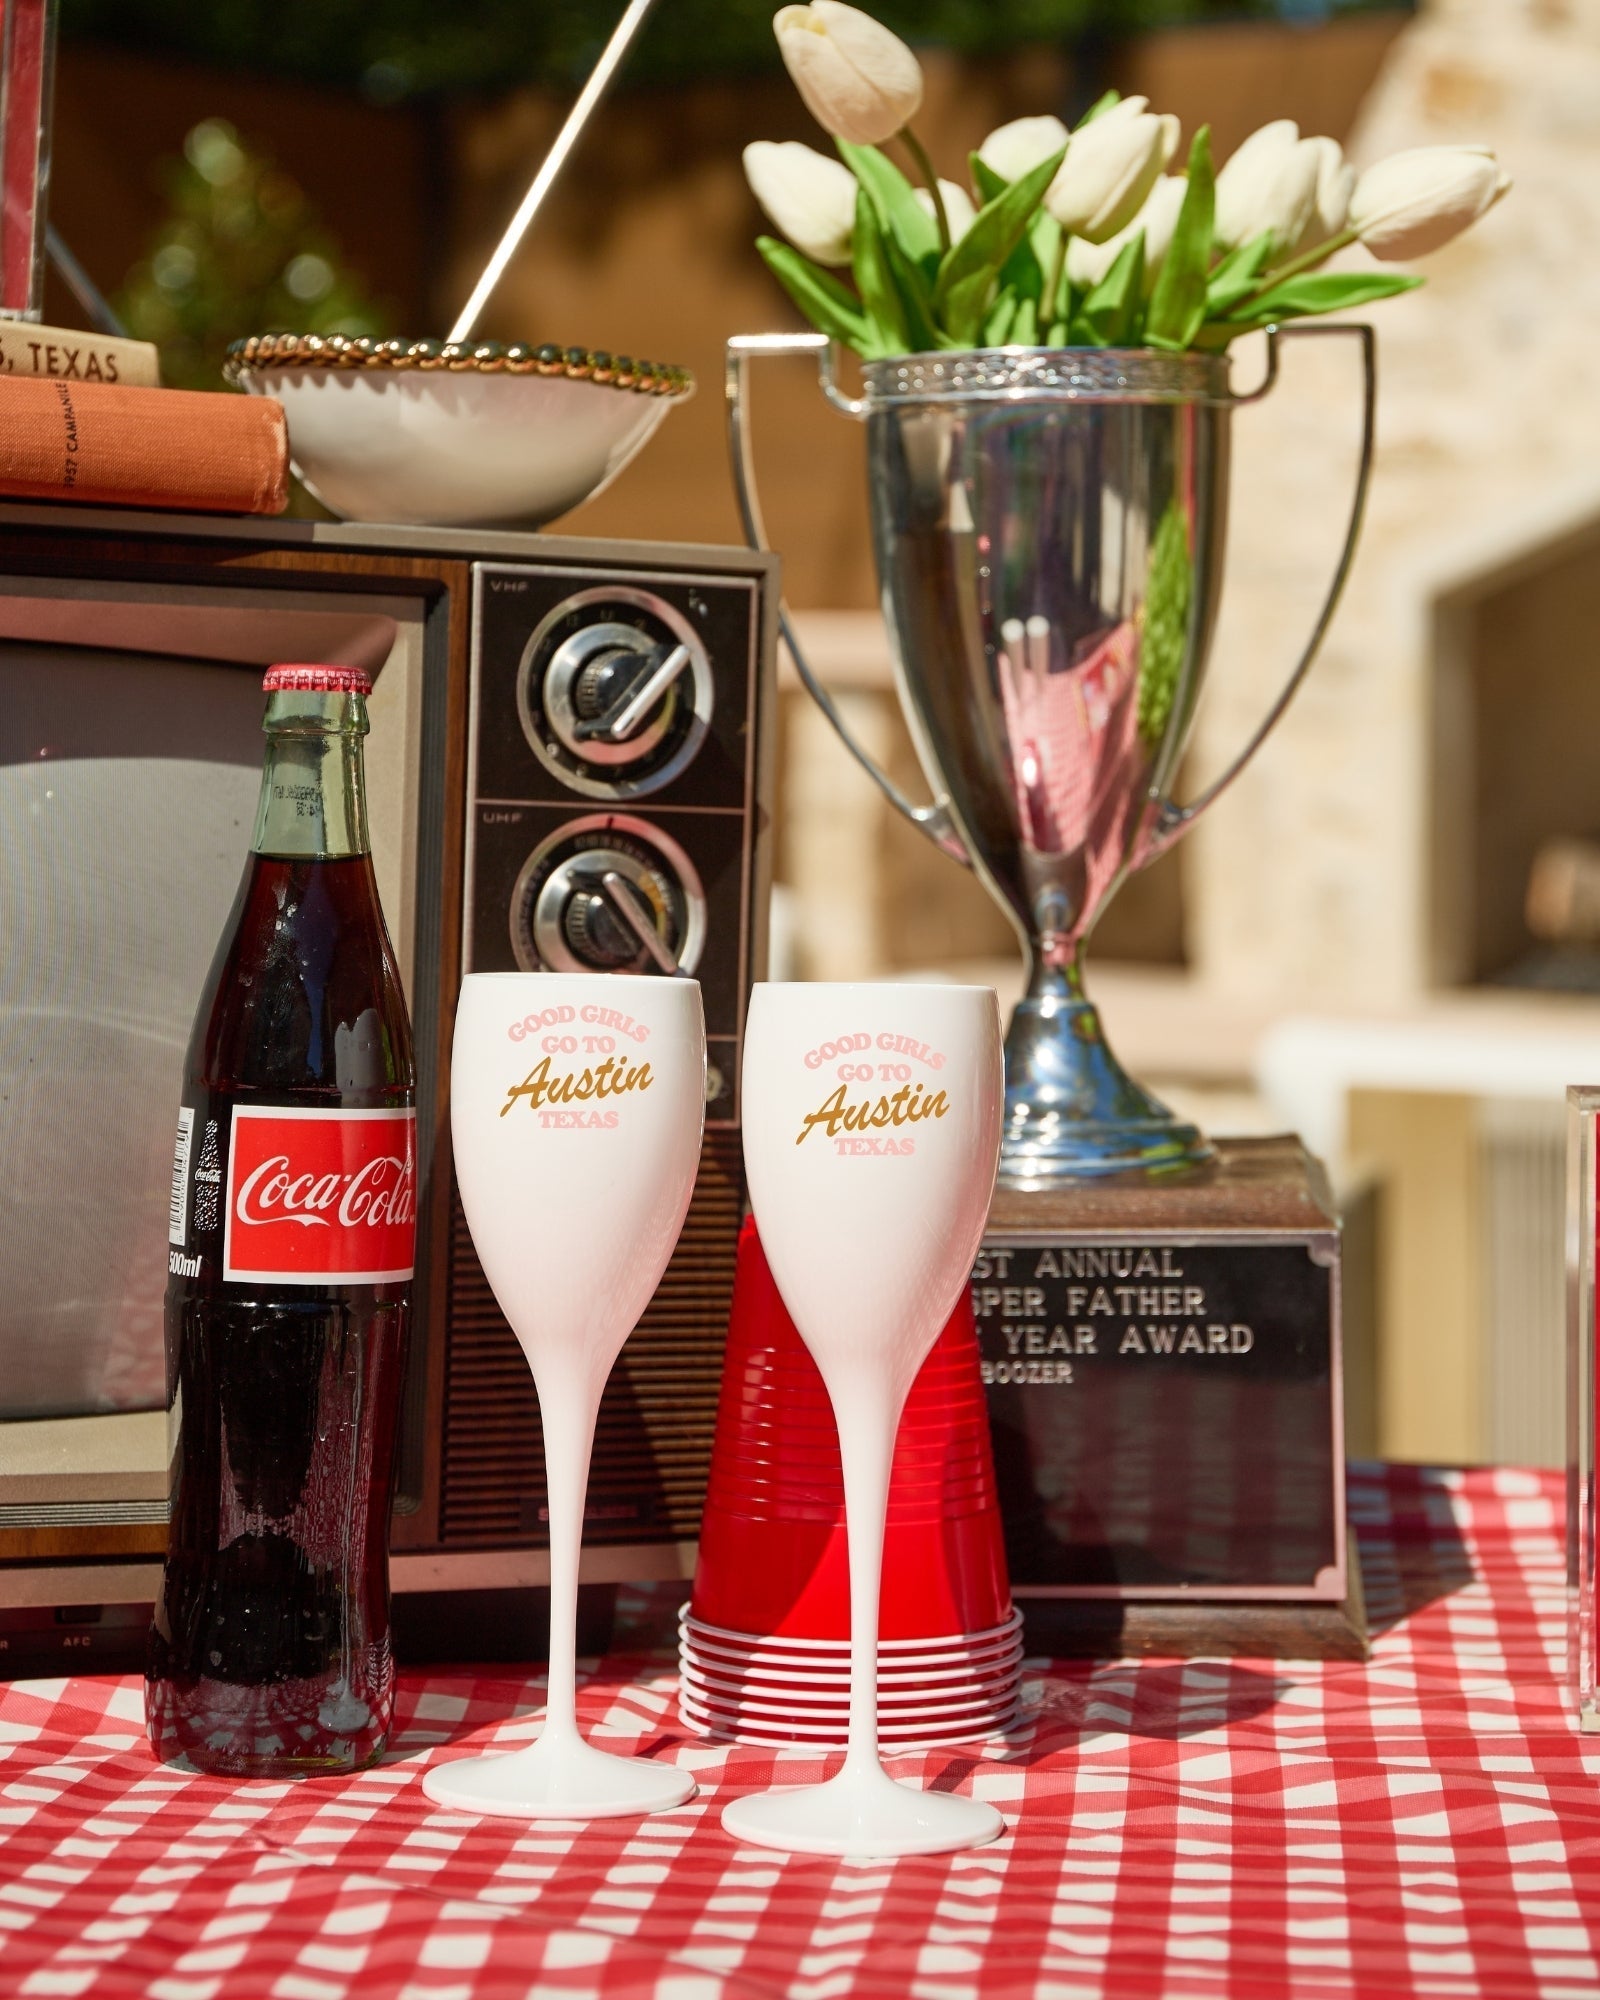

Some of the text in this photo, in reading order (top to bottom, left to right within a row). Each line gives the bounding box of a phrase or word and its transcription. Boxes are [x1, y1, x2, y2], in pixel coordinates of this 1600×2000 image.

[27, 342, 119, 383] TEXAS
[55, 382, 79, 488] 1957 CAMPANILE
[489, 580, 529, 592] VHF
[482, 812, 523, 824] UHF
[507, 1004, 651, 1043] GOOD GIRLS
[541, 1035, 616, 1054] GO TO
[803, 1032, 947, 1071] GOOD GIRLS
[499, 1056, 655, 1117] Austin
[837, 1063, 912, 1082] GO TO
[537, 1110, 620, 1129] TEXAS
[795, 1083, 950, 1145] Austin
[833, 1137, 916, 1156] TEXAS
[235, 1155, 415, 1227] Coca-Cola
[168, 1251, 203, 1278] 500ml
[1034, 1248, 1184, 1278] ANNUAL
[1066, 1286, 1208, 1316] FATHER
[1001, 1324, 1099, 1354] YEAR
[1119, 1324, 1255, 1354] AWARD
[981, 1360, 1075, 1384] BOOZER
